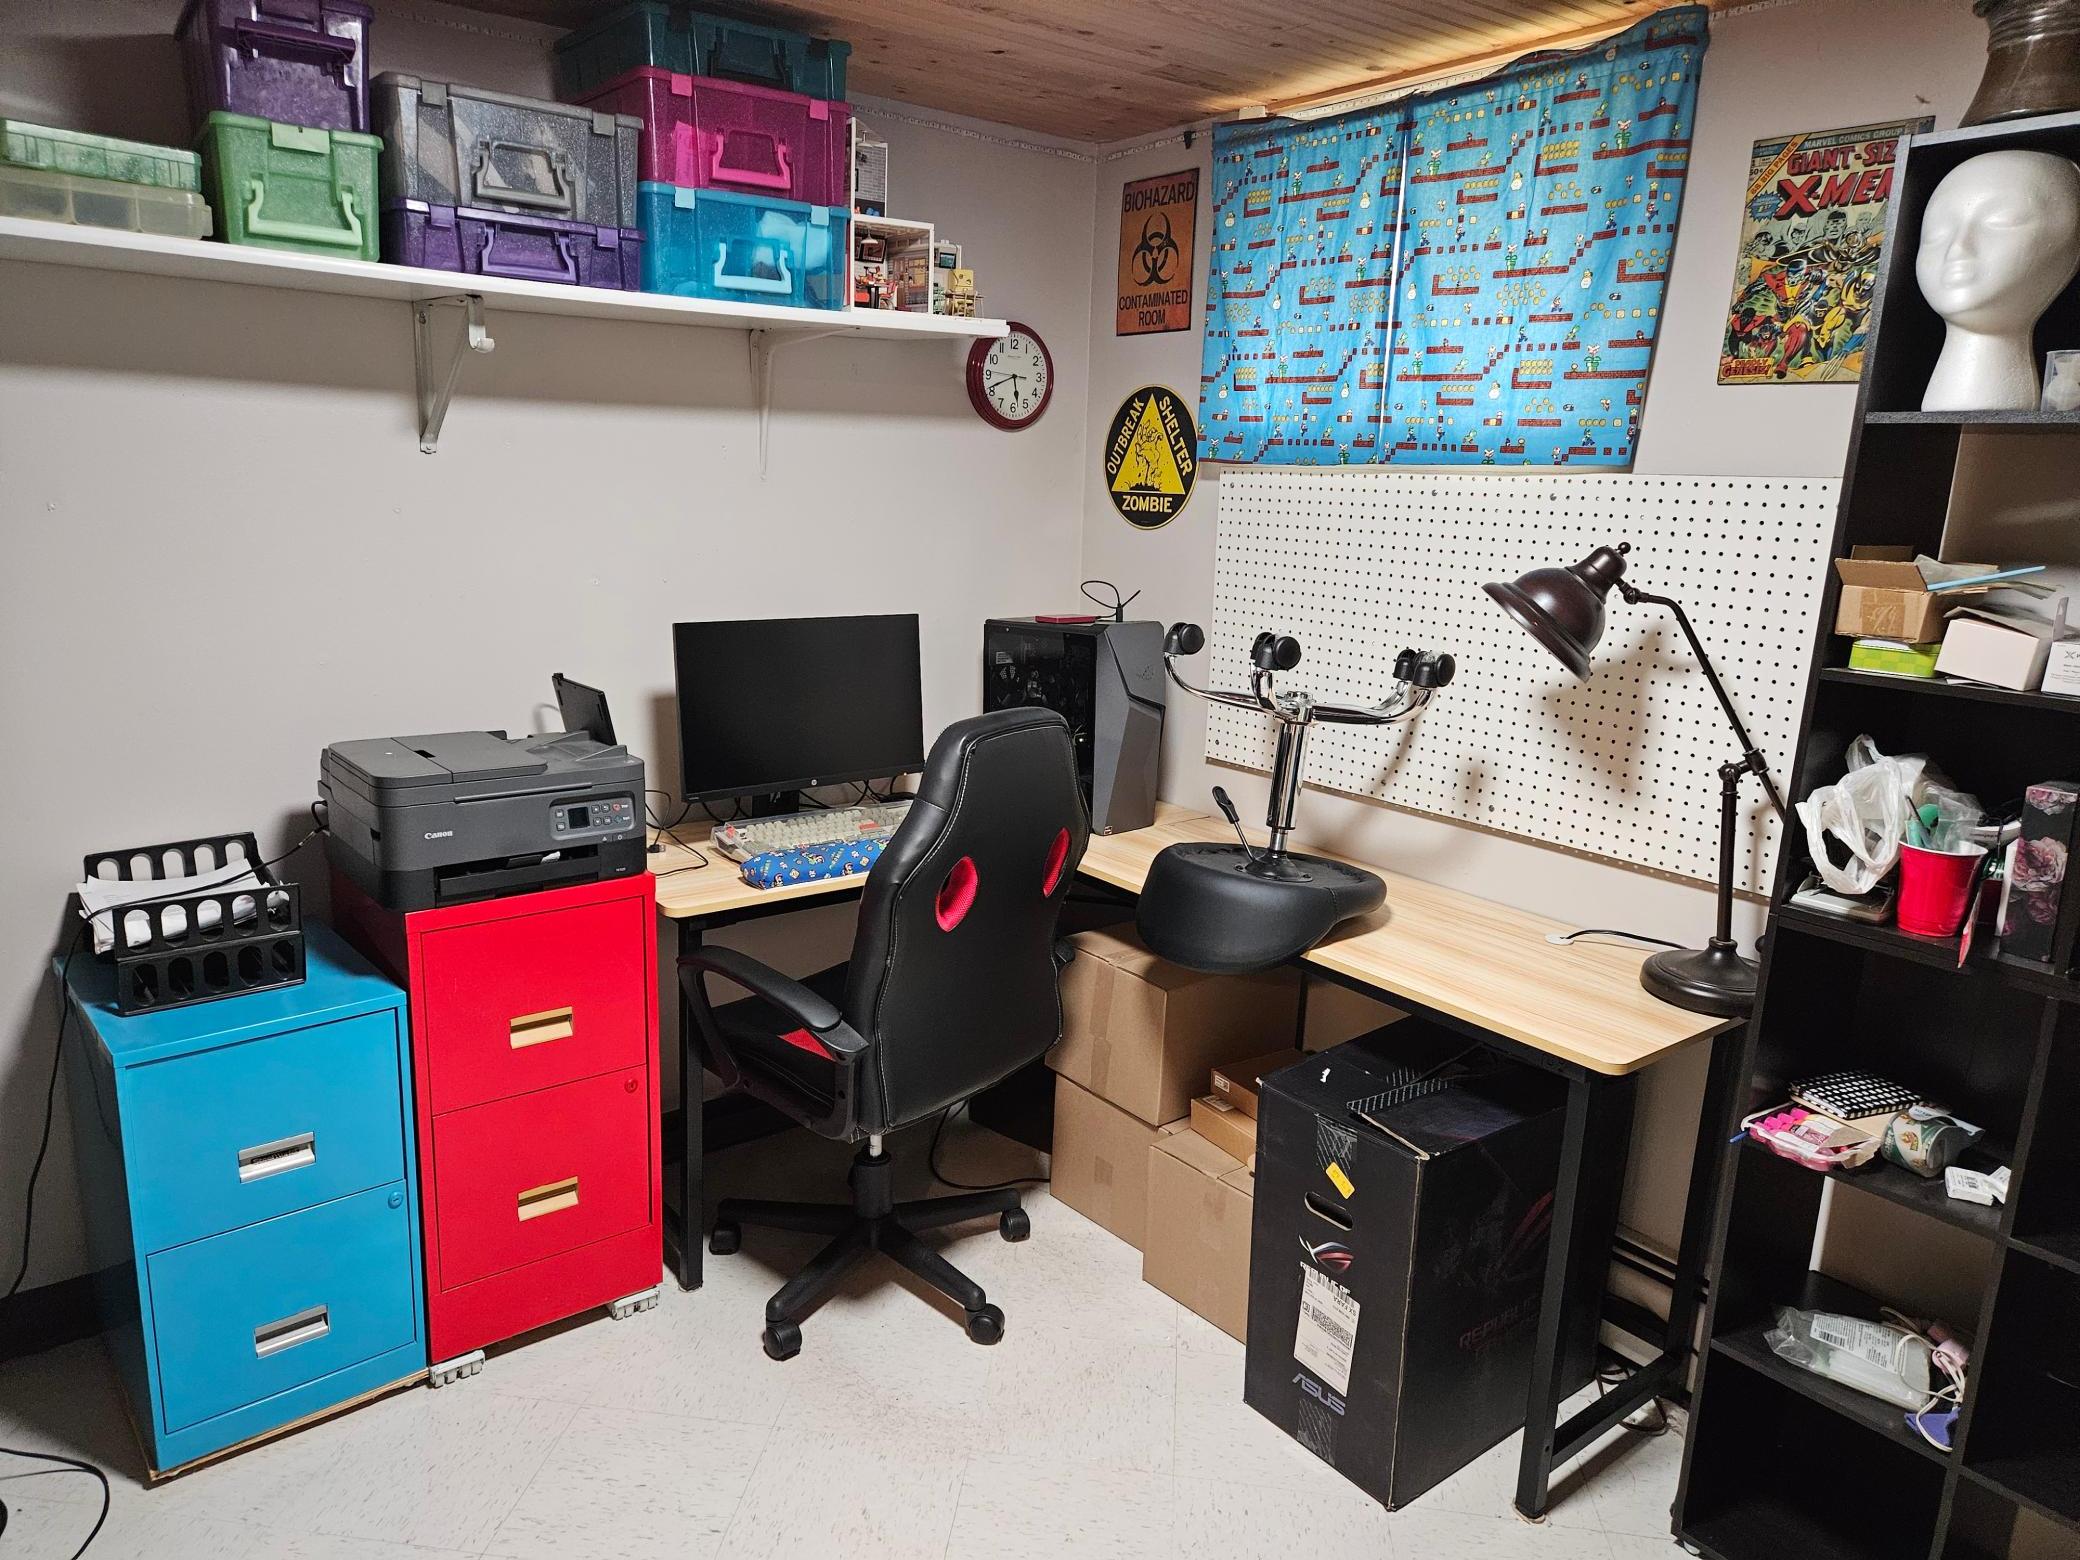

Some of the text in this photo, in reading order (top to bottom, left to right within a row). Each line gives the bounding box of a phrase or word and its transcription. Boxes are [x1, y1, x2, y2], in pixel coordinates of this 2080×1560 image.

[1804, 128, 1902, 149] MARVEL COMICS GROUP
[1760, 168, 1775, 182] BIG
[1774, 141, 1798, 168] PAGES
[1786, 139, 1899, 176] GIANT-SIZ
[1124, 182, 1195, 213] BIOHAZARD
[1119, 289, 1189, 311] CONTAMINATED
[1138, 309, 1166, 327] ROOM
[1000, 342, 1004, 353] 11
[1010, 339, 1019, 349] 12
[989, 354, 999, 365] 10
[1032, 355, 1039, 367] 2
[985, 369, 992, 380] 9
[1035, 372, 1042, 383] 3
[988, 386, 995, 397] 8
[1031, 387, 1038, 398] 4
[998, 397, 1004, 409] 7
[1010, 402, 1017, 413] 6
[1022, 399, 1029, 409] 5
[1107, 397, 1145, 475] OUTBREAK
[1159, 395, 1193, 477] SHELTER
[1122, 495, 1173, 513] ZOMBIE
[424, 830, 453, 840] Canon
[1292, 1373, 1346, 1416] ASUS
